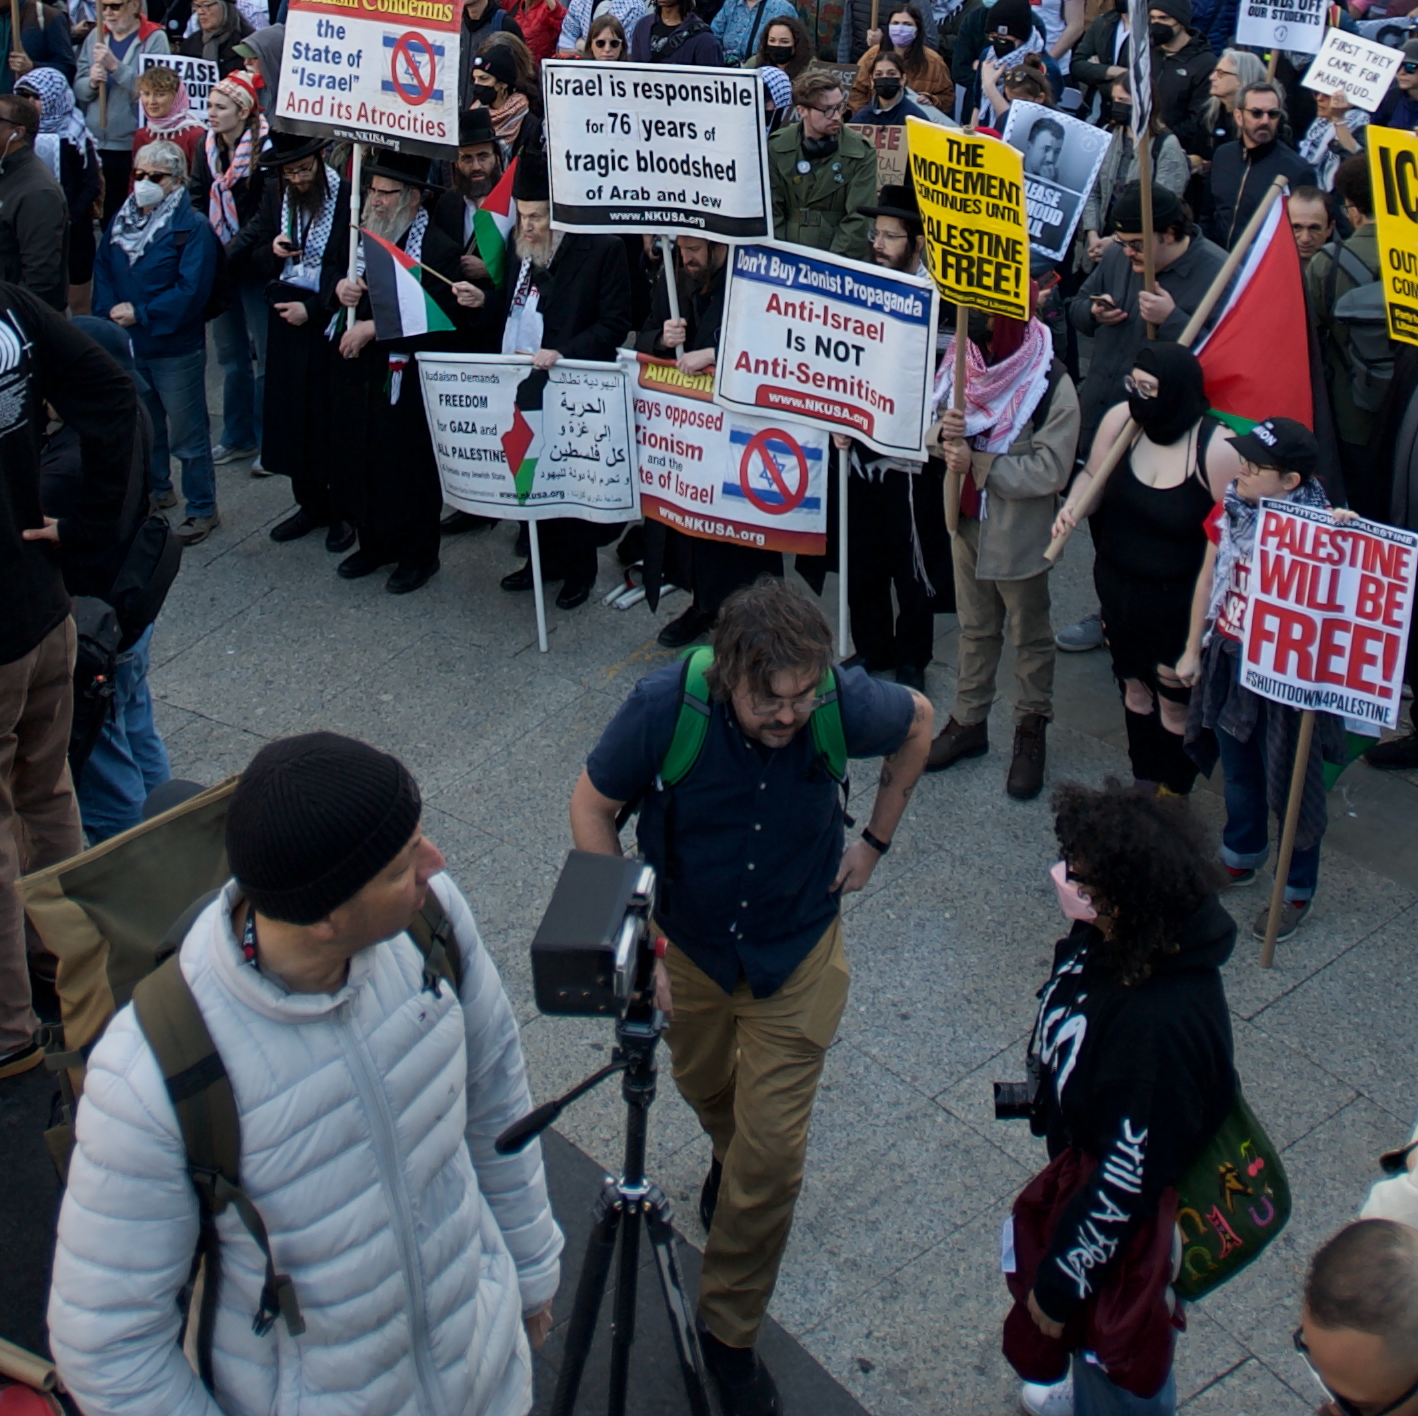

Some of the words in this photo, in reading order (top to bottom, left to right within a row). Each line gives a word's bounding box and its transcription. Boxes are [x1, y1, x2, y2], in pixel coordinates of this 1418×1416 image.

[317, 19, 345, 40] the
[1248, 6, 1267, 17] OUR
[1272, 9, 1320, 26] STUDENTS
[292, 42, 342, 64] State
[348, 50, 362, 68] of
[1331, 37, 1363, 57] FIRST
[1327, 57, 1357, 75] CAME
[1361, 68, 1381, 84] FOR
[550, 72, 602, 96] Israel
[610, 75, 626, 97] is
[633, 81, 752, 106] responsible
[286, 92, 323, 116] And
[331, 97, 352, 120] its
[357, 102, 446, 137] Atrocities
[586, 119, 604, 133] for
[608, 113, 631, 134] 76
[642, 118, 697, 142] years
[704, 127, 715, 141] of
[565, 149, 629, 177] tragic
[636, 150, 736, 182] bloodshed
[946, 138, 984, 168] THE
[913, 154, 1020, 207] MOVEMENT
[586, 186, 603, 200] of
[610, 186, 650, 200] Arab
[657, 189, 686, 202] and
[692, 192, 721, 208] Jew
[610, 211, 705, 227] www.NKUSA.org
[986, 202, 1022, 225] UNTIL
[941, 248, 1021, 299] FREE!
[1389, 248, 1418, 277] OUT
[769, 258, 796, 286] Buy
[798, 266, 843, 295] Zionist
[844, 275, 923, 318] Propaganda
[765, 293, 885, 344] Anti-Israel
[786, 328, 807, 352] Is
[815, 335, 865, 367] NOT
[425, 371, 458, 383] Judaism
[461, 373, 500, 383] Demands
[734, 350, 895, 416] Anti-Semitism
[439, 394, 488, 408] FREEDOM
[437, 421, 448, 432] for
[450, 421, 477, 435] GAZA
[480, 424, 497, 436] and
[568, 424, 589, 437] غزة
[665, 402, 724, 432] opposed
[438, 443, 450, 457] ALL
[452, 446, 507, 463] PALESTINE
[648, 455, 666, 467] and
[668, 457, 683, 471] the
[659, 469, 672, 490] of
[674, 473, 714, 504] Israel
[658, 506, 765, 546] www.NKUSA.org
[1260, 511, 1412, 583] PALESTINE
[1260, 549, 1345, 613] WILL
[1355, 573, 1407, 629] BE
[1247, 598, 1401, 700] FREE!
